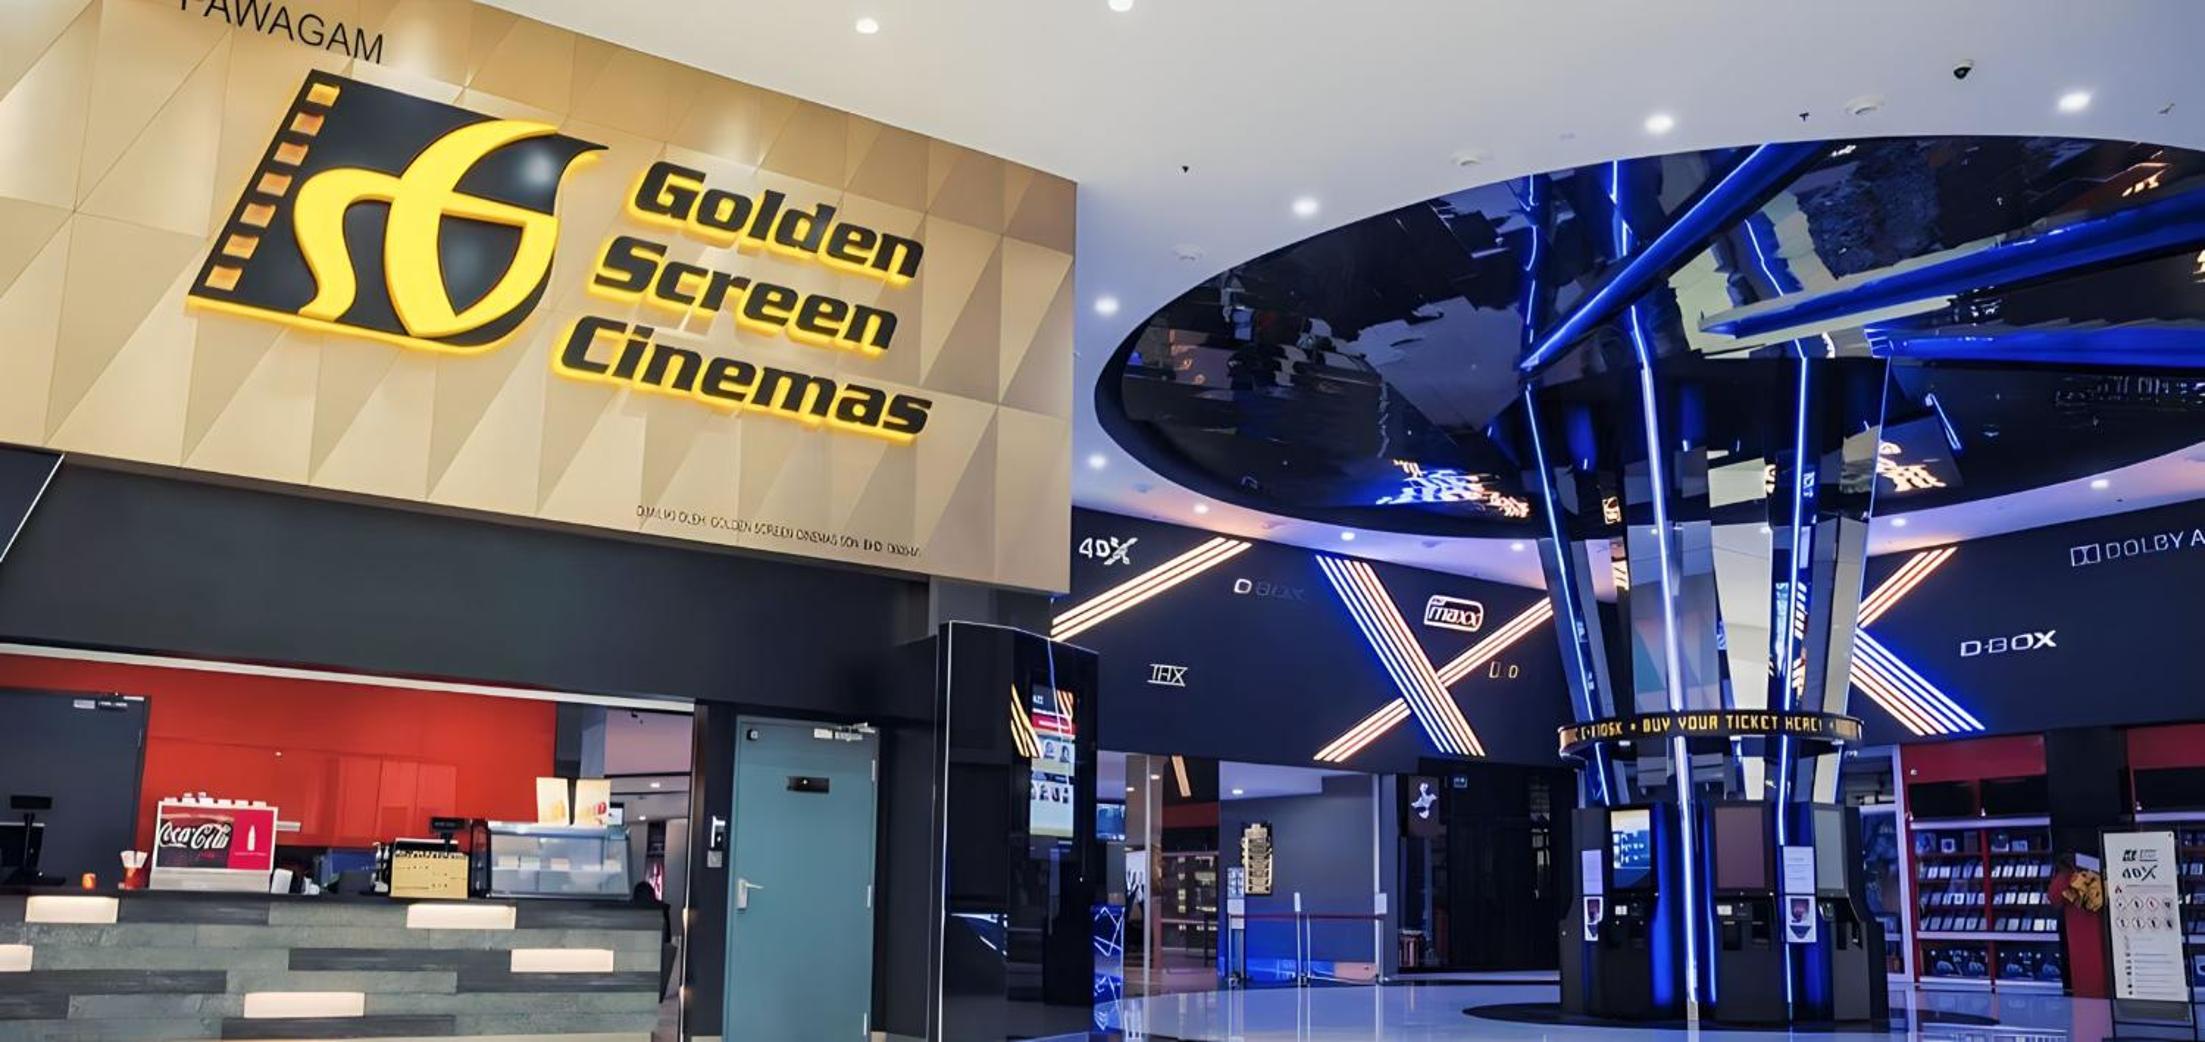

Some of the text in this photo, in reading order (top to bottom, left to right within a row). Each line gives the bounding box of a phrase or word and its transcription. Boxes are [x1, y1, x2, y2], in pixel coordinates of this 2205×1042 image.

[628, 160, 924, 284] Golden
[592, 235, 898, 355] Screen
[556, 315, 933, 440] Cinemas
[1078, 536, 1138, 565] 4DX
[2105, 531, 2184, 560] DOLBY
[1427, 606, 1477, 627] maxx
[1959, 630, 2057, 658] D-BOX
[1642, 717, 1671, 733] BUY
[1677, 714, 1719, 730] YOUR
[1725, 714, 1779, 730] TICKET
